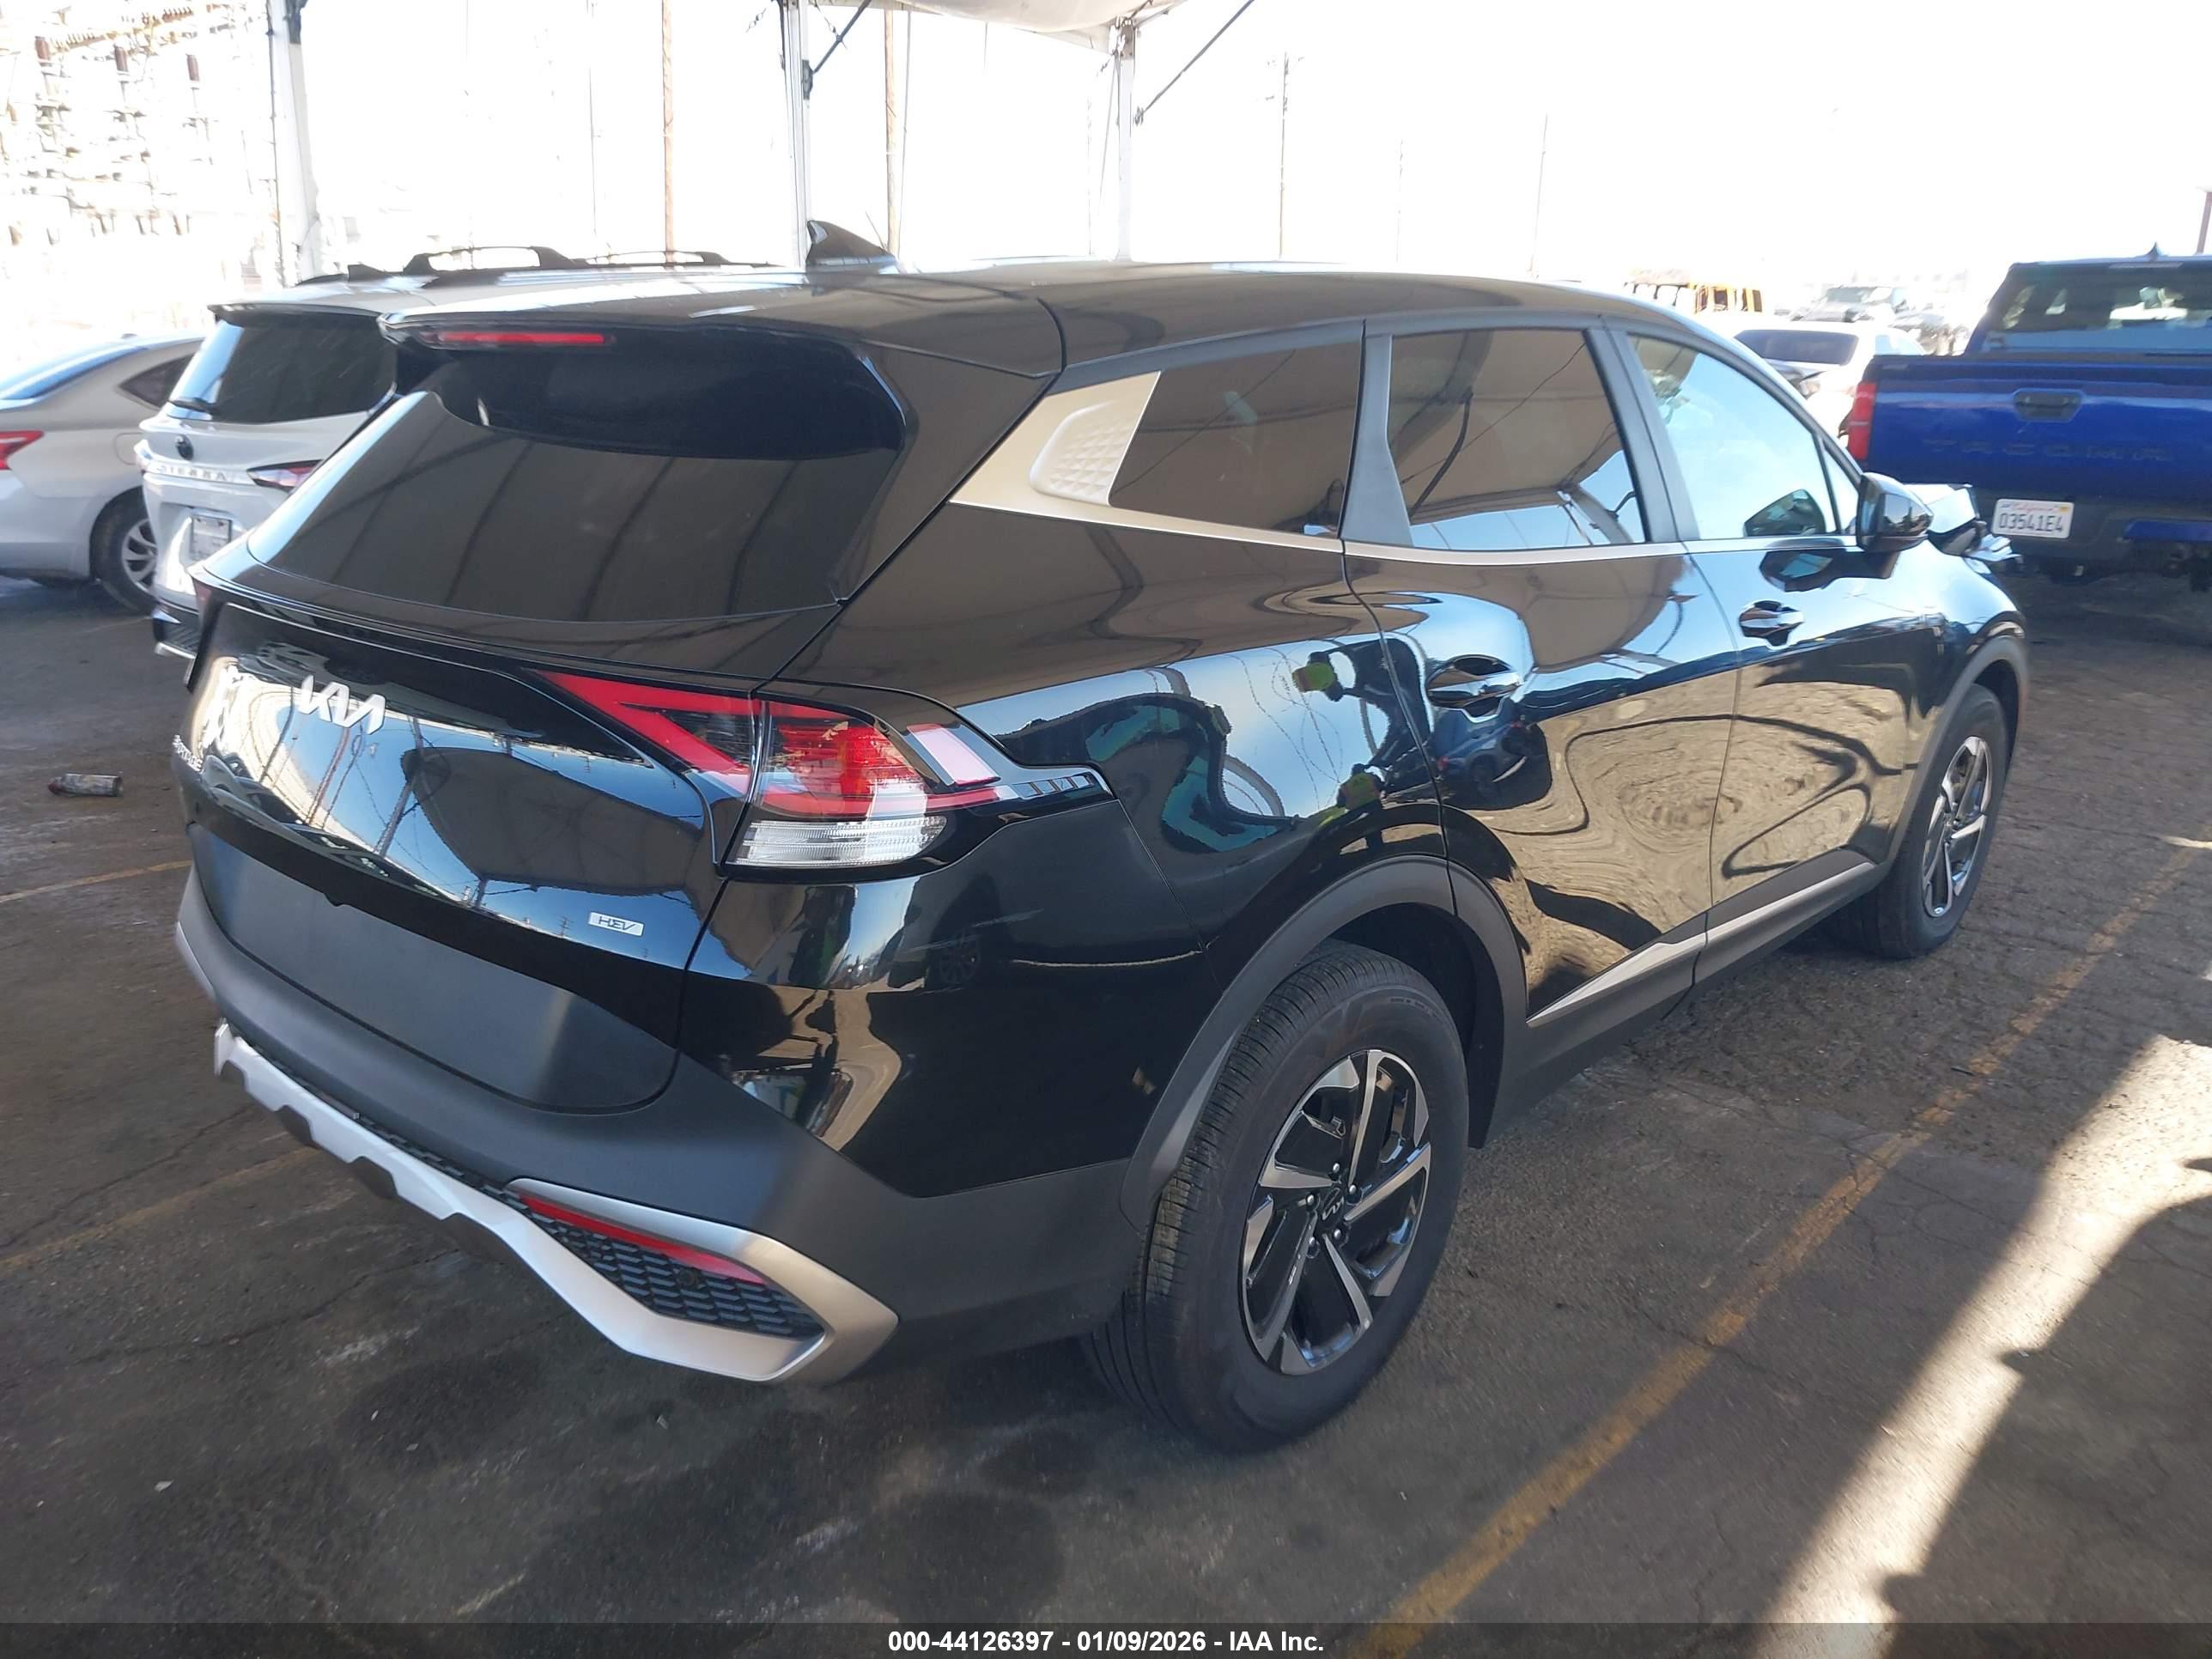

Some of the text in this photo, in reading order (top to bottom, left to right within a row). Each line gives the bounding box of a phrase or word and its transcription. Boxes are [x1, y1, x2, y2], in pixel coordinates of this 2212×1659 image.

[1923, 439, 2172, 461] TACOMA
[1998, 513, 2064, 532] 03541E4
[298, 674, 386, 735] KIA
[599, 915, 635, 931] HEV
